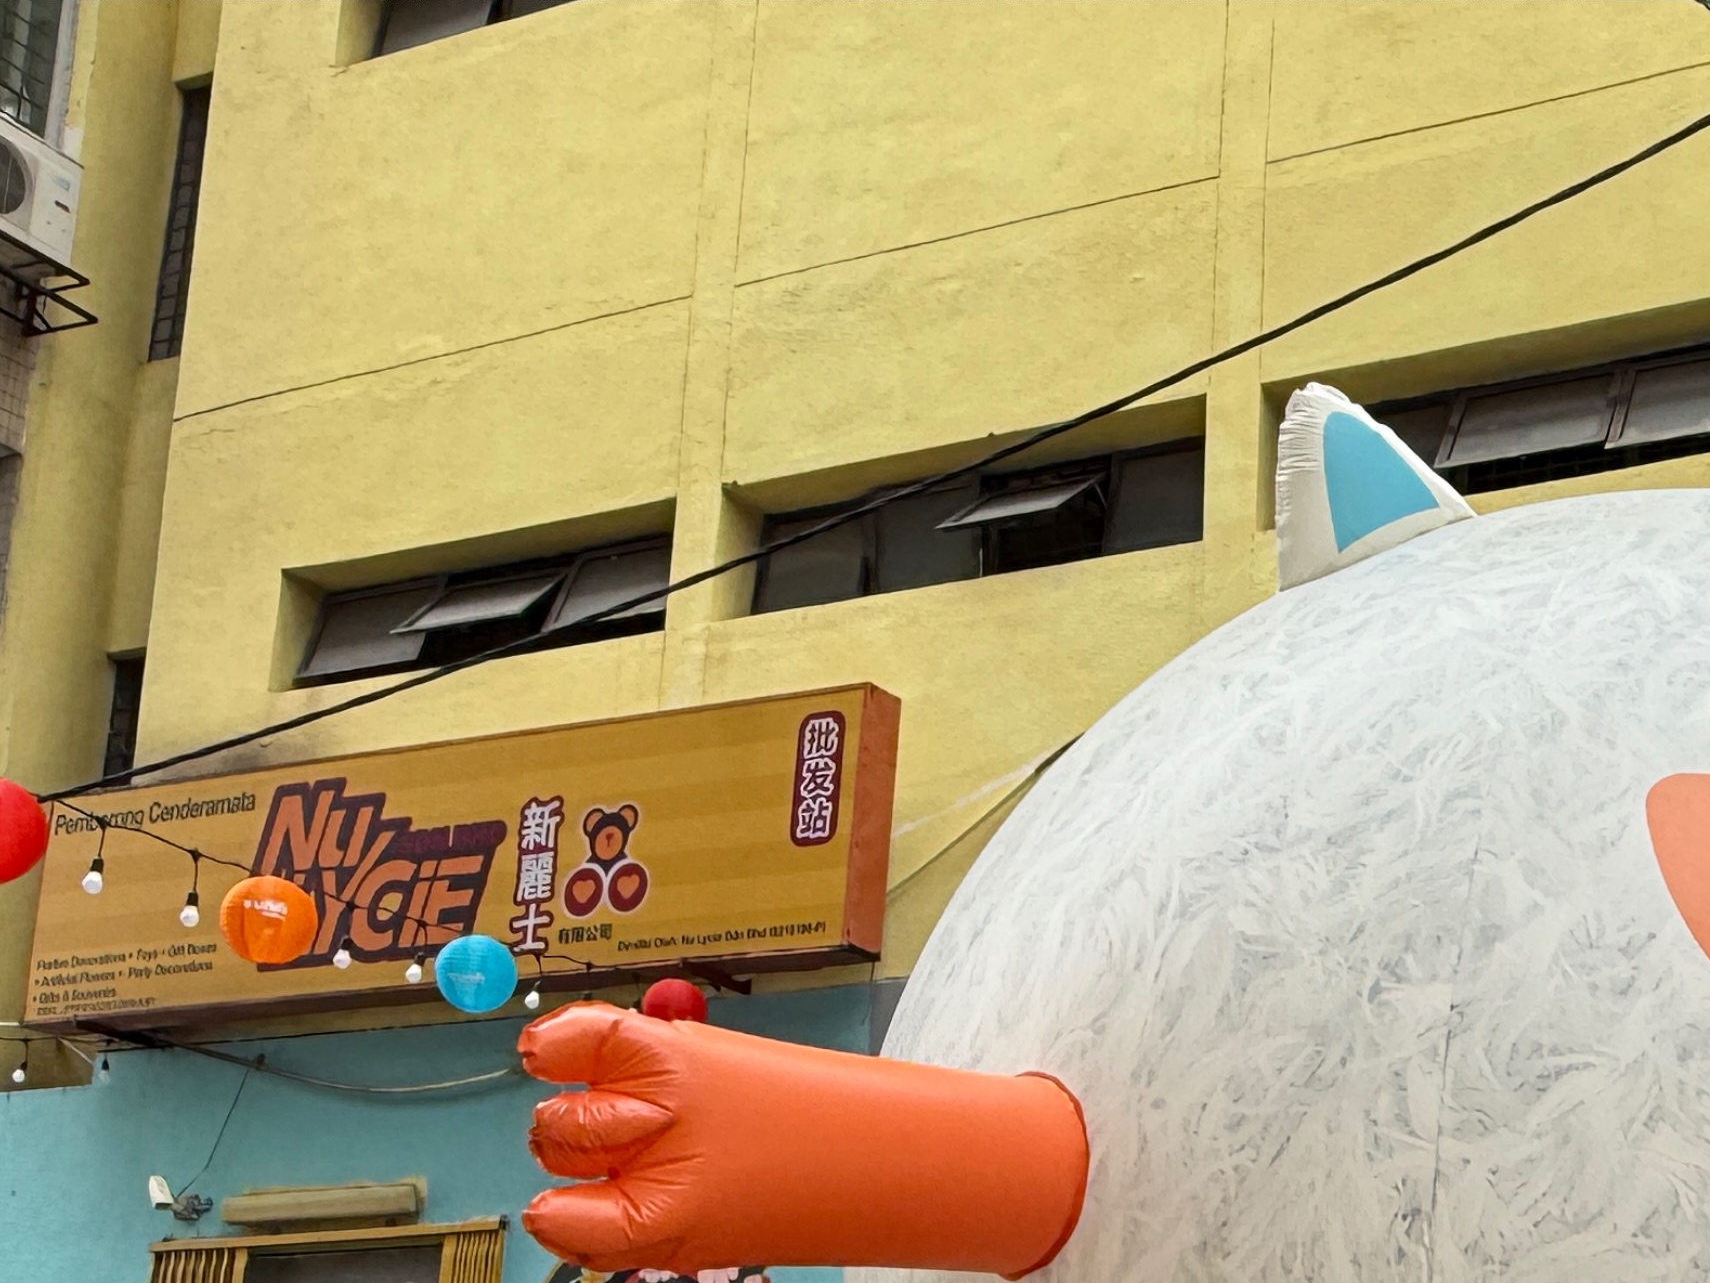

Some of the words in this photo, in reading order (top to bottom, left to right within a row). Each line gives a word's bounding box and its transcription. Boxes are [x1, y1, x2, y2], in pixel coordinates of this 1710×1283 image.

[149, 791, 256, 824] Cenderamata
[797, 717, 839, 839] 批发站
